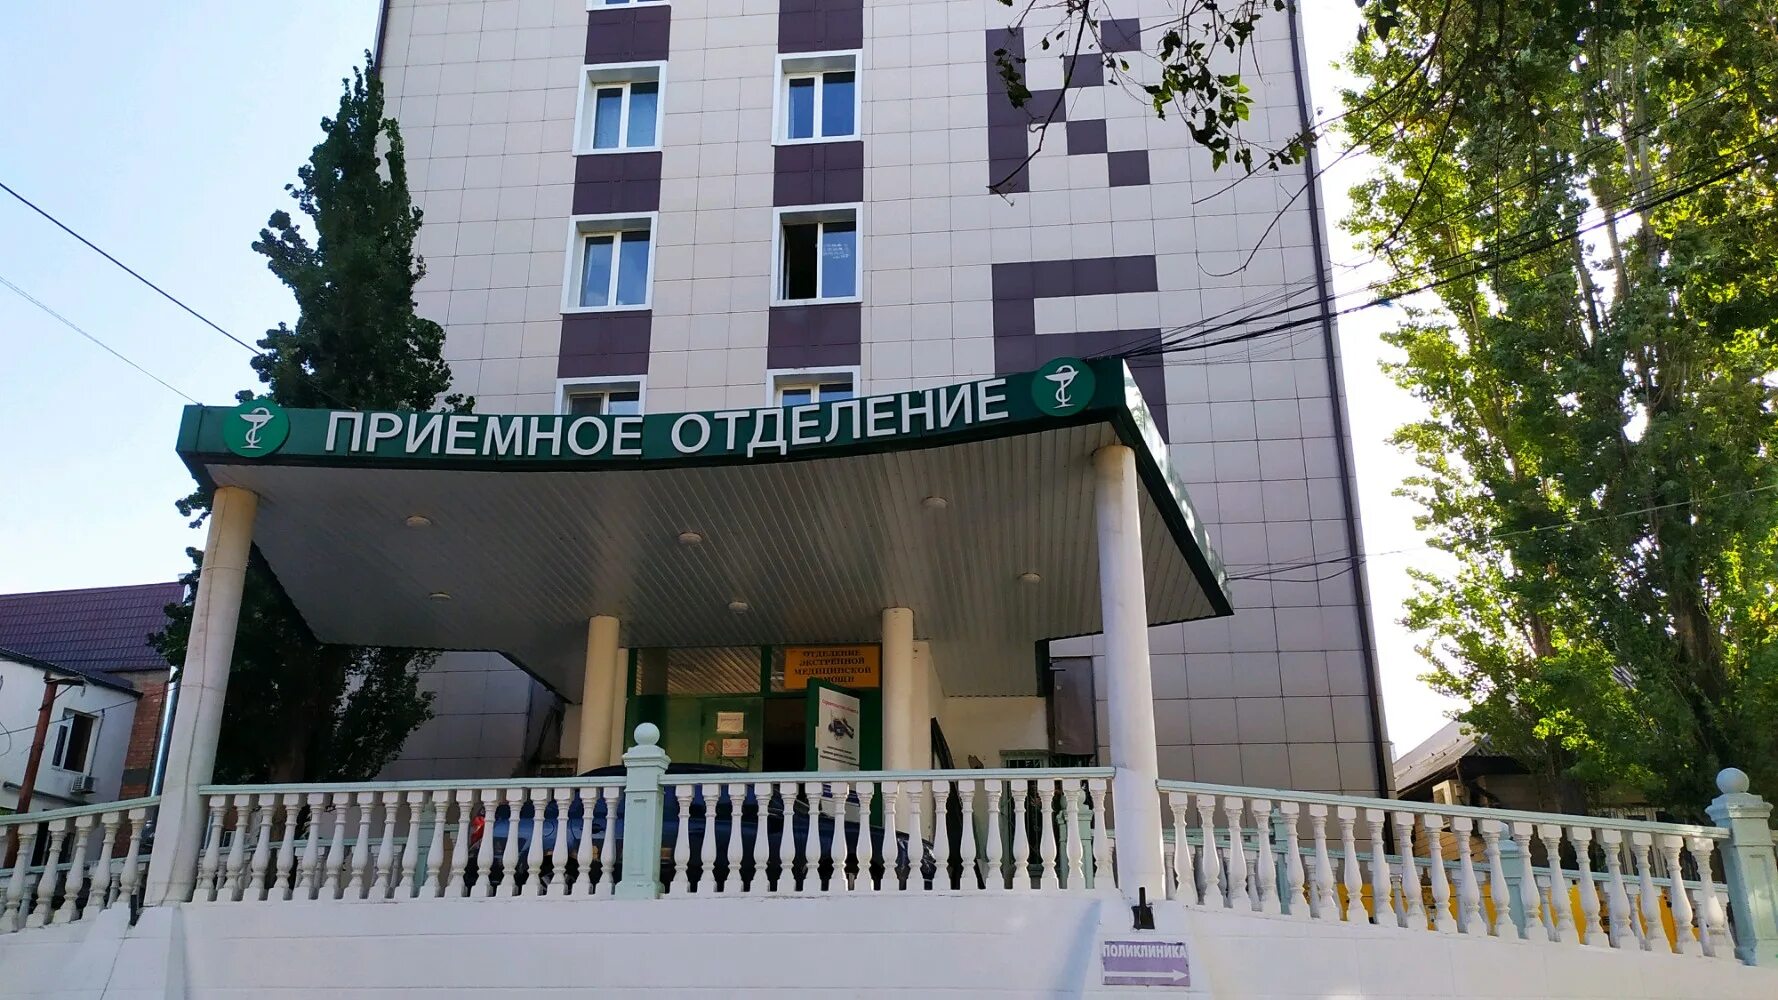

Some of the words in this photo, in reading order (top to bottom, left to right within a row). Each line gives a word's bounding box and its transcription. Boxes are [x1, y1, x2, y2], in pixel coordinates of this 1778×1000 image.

[325, 411, 644, 456] ПРИЕМНОЕ
[671, 378, 1009, 458] ОТДЕЛЕНИЕ
[794, 666, 872, 675] МЕДИЦИНСКОЙ
[1103, 944, 1187, 958] ПОЛИКЛИНИКА
